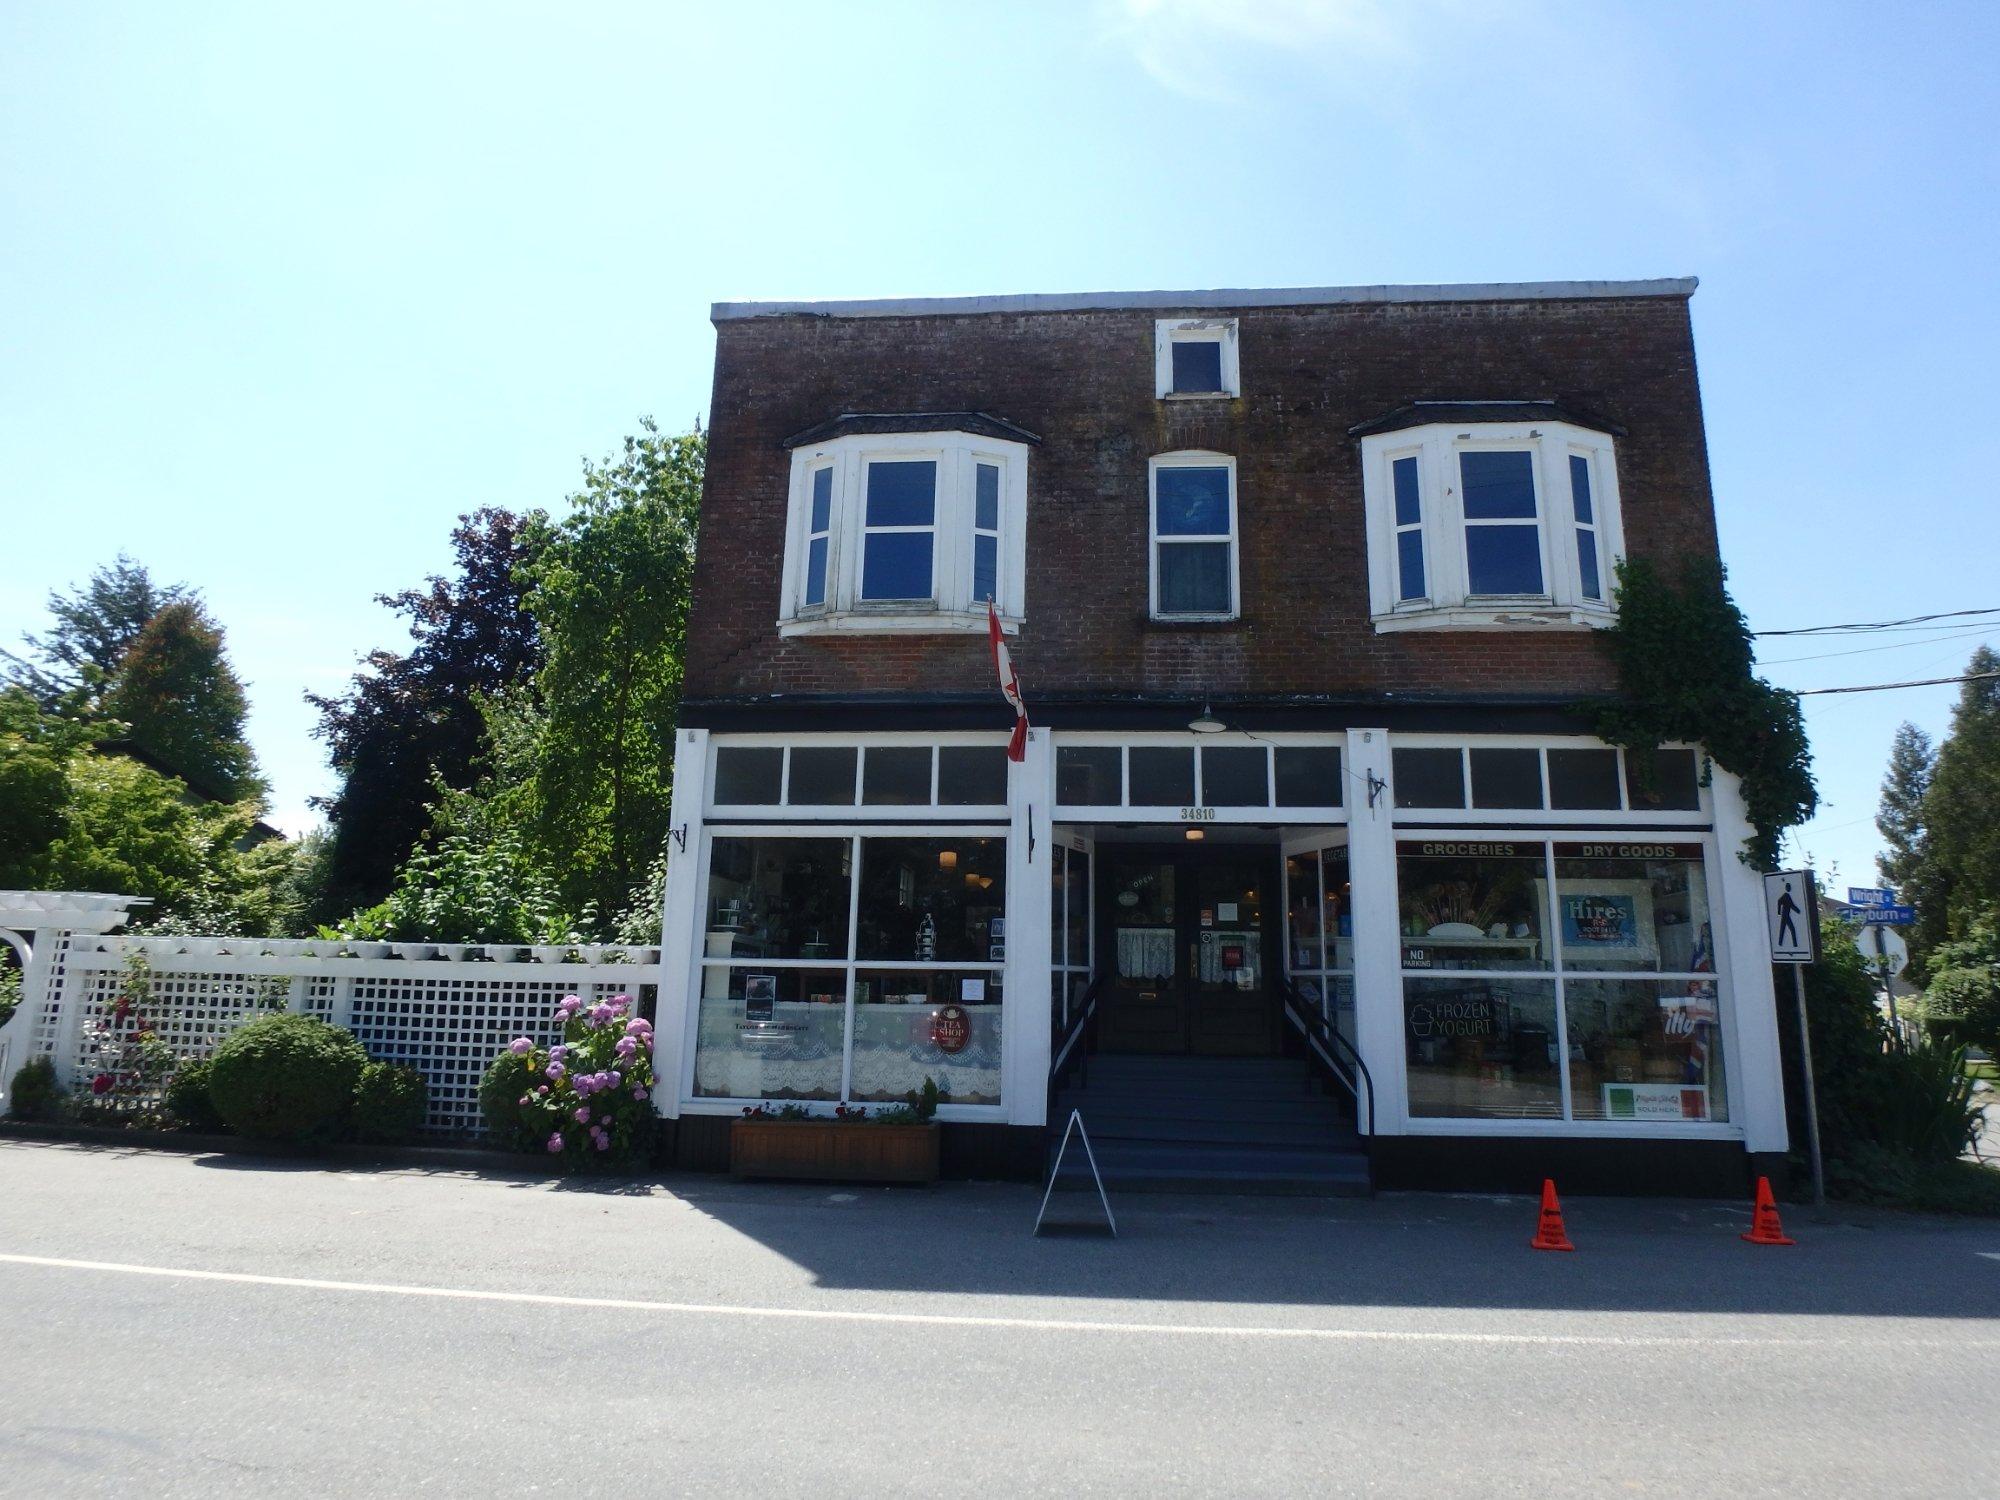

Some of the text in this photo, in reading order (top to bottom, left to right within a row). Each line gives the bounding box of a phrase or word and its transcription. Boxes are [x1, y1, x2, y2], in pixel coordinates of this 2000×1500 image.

[1181, 808, 1215, 820] 34810
[1422, 843, 1515, 855] GROCERIES
[1583, 845, 1676, 857] DRY GOODS
[1851, 889, 1883, 904] Wright
[1568, 899, 1627, 919] Hires
[1410, 950, 1424, 960] NO
[1436, 1003, 1490, 1018] FROZEN
[944, 1021, 961, 1029] TEA
[1435, 1019, 1492, 1036] YOGURT
[939, 1029, 964, 1037] SHOP
